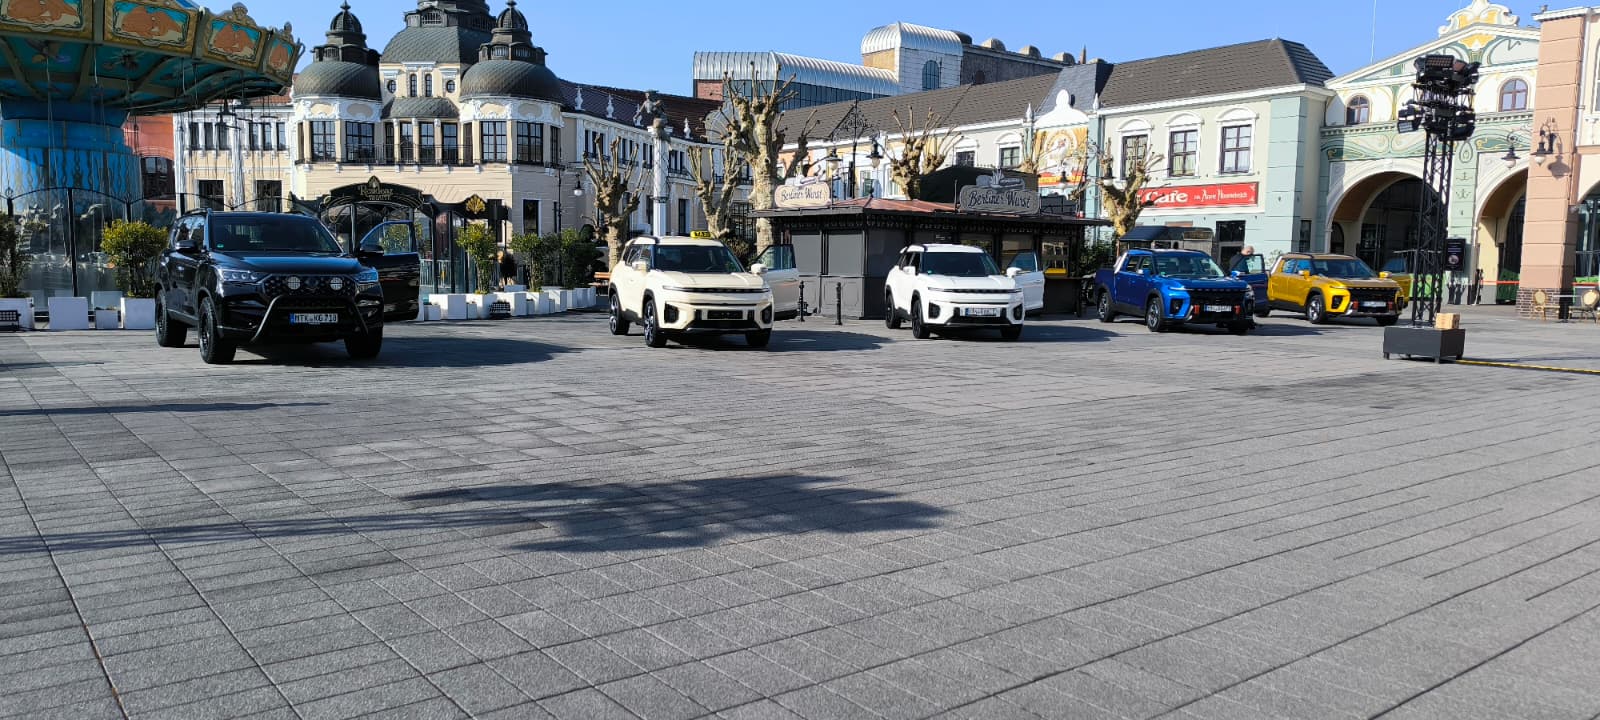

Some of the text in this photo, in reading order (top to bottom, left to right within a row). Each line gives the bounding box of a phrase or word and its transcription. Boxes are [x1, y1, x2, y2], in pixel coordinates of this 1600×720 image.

[782, 187, 823, 200] Berliner Wurst
[968, 190, 1031, 208] Berliner Wurst
